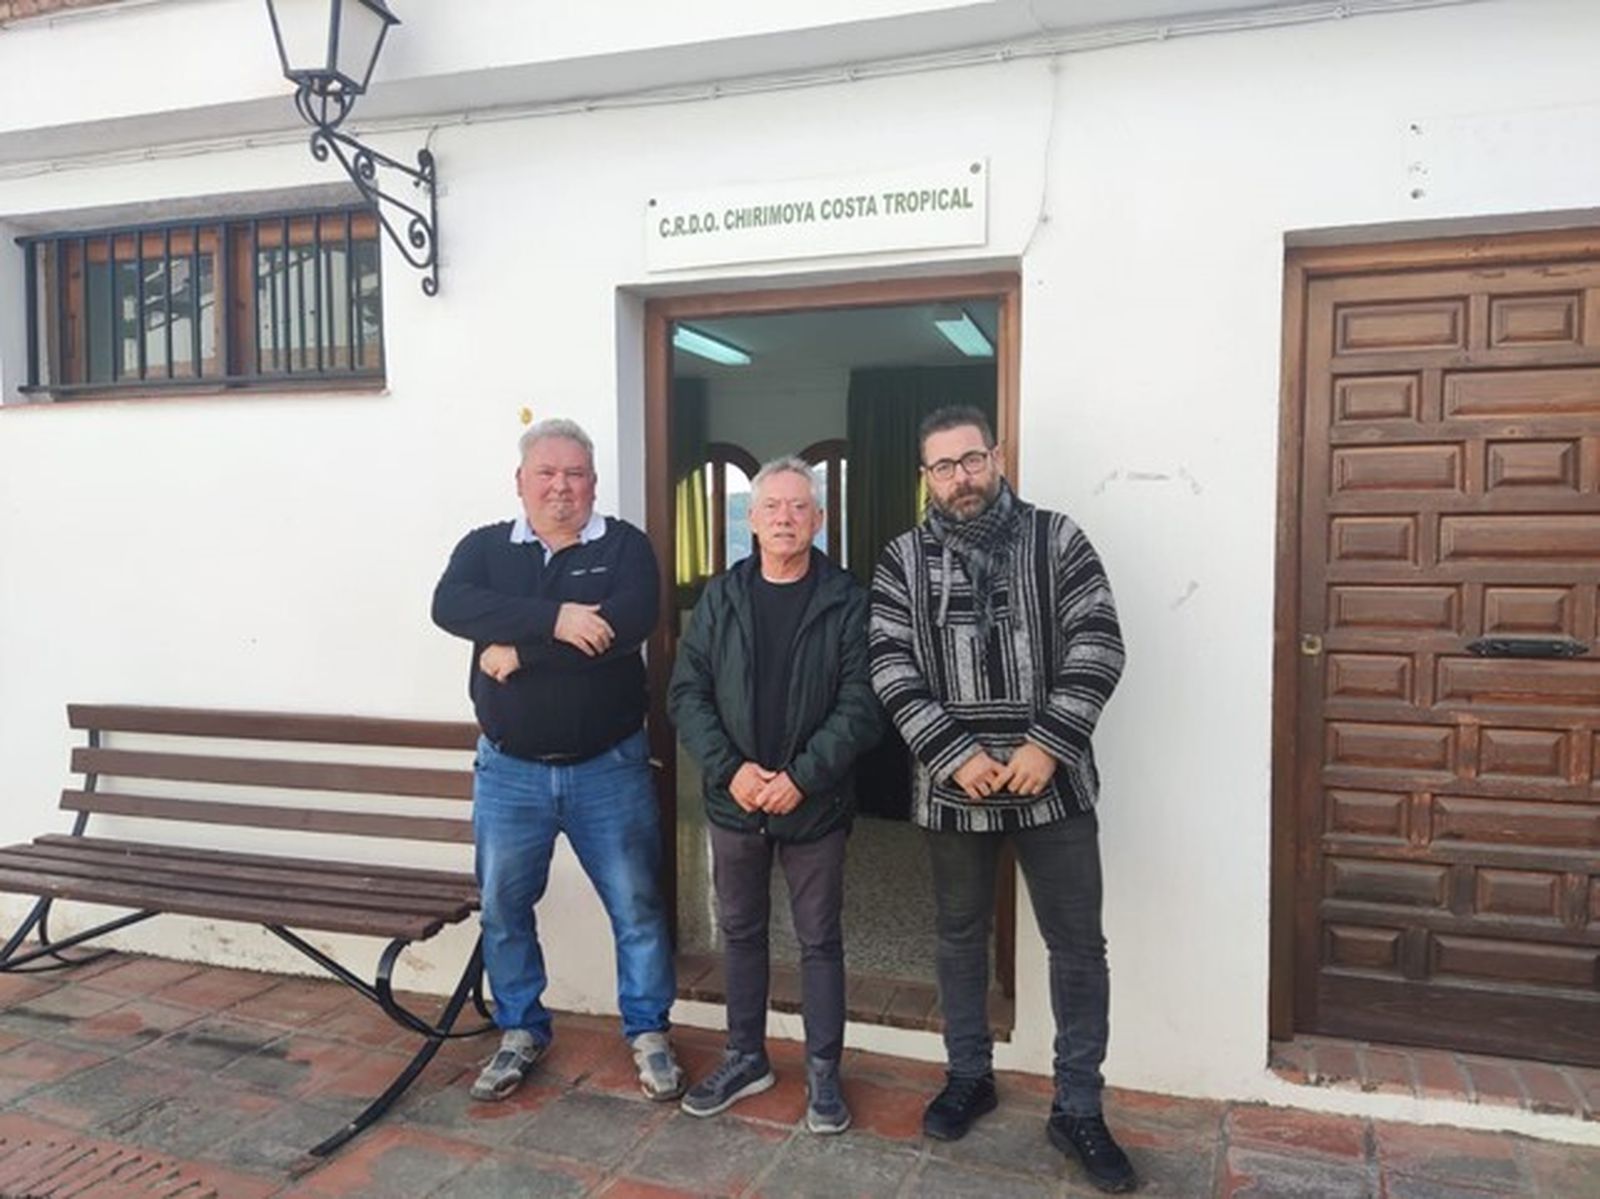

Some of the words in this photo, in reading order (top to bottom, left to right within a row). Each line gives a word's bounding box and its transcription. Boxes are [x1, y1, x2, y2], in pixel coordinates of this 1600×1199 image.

[659, 212, 719, 238] C.R.D.O.
[723, 202, 815, 231] CHIRIMOYA
[820, 195, 878, 220] COSTA
[883, 187, 974, 214] TROPICAL
